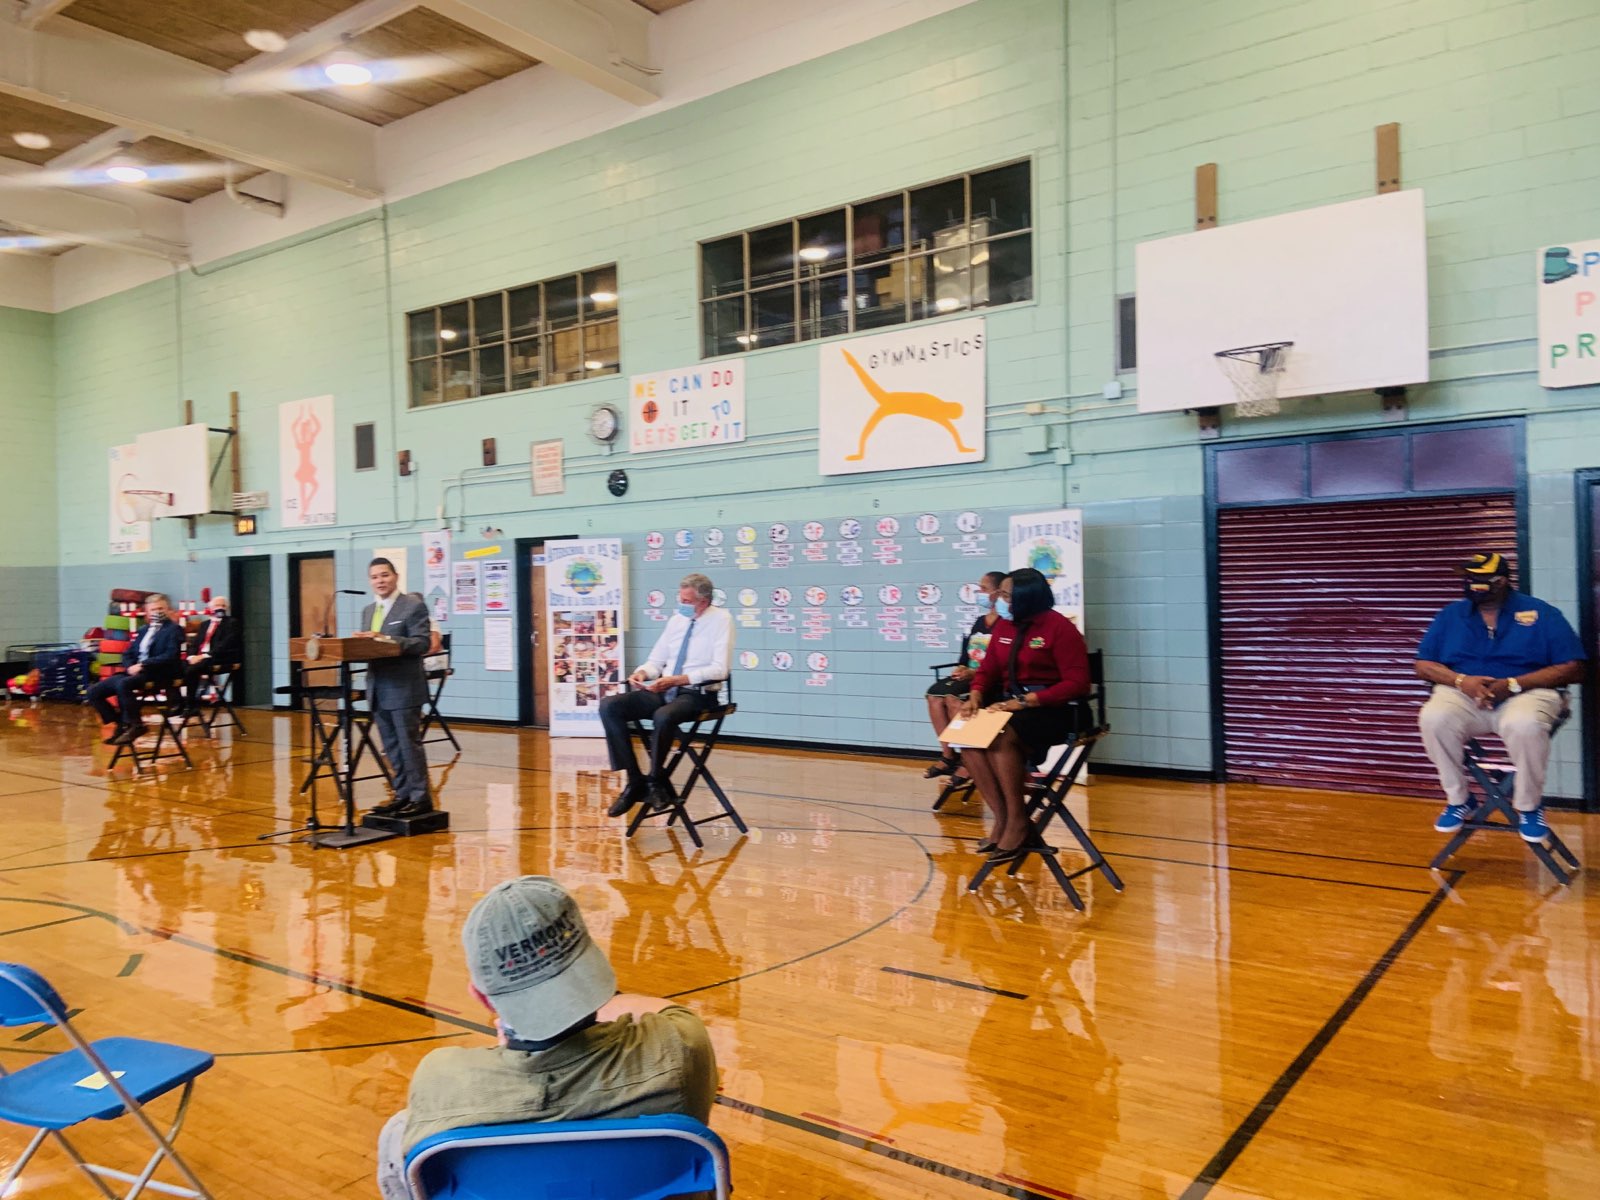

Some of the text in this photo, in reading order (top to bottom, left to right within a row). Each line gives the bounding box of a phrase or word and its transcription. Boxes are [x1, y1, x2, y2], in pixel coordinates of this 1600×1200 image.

[868, 334, 983, 369] GYMNASTICS
[635, 369, 734, 398] WE CAN DO
[673, 399, 731, 420] IT TO
[681, 421, 708, 440] GET
[724, 421, 742, 440] IT
[494, 910, 576, 962] VERMONT
